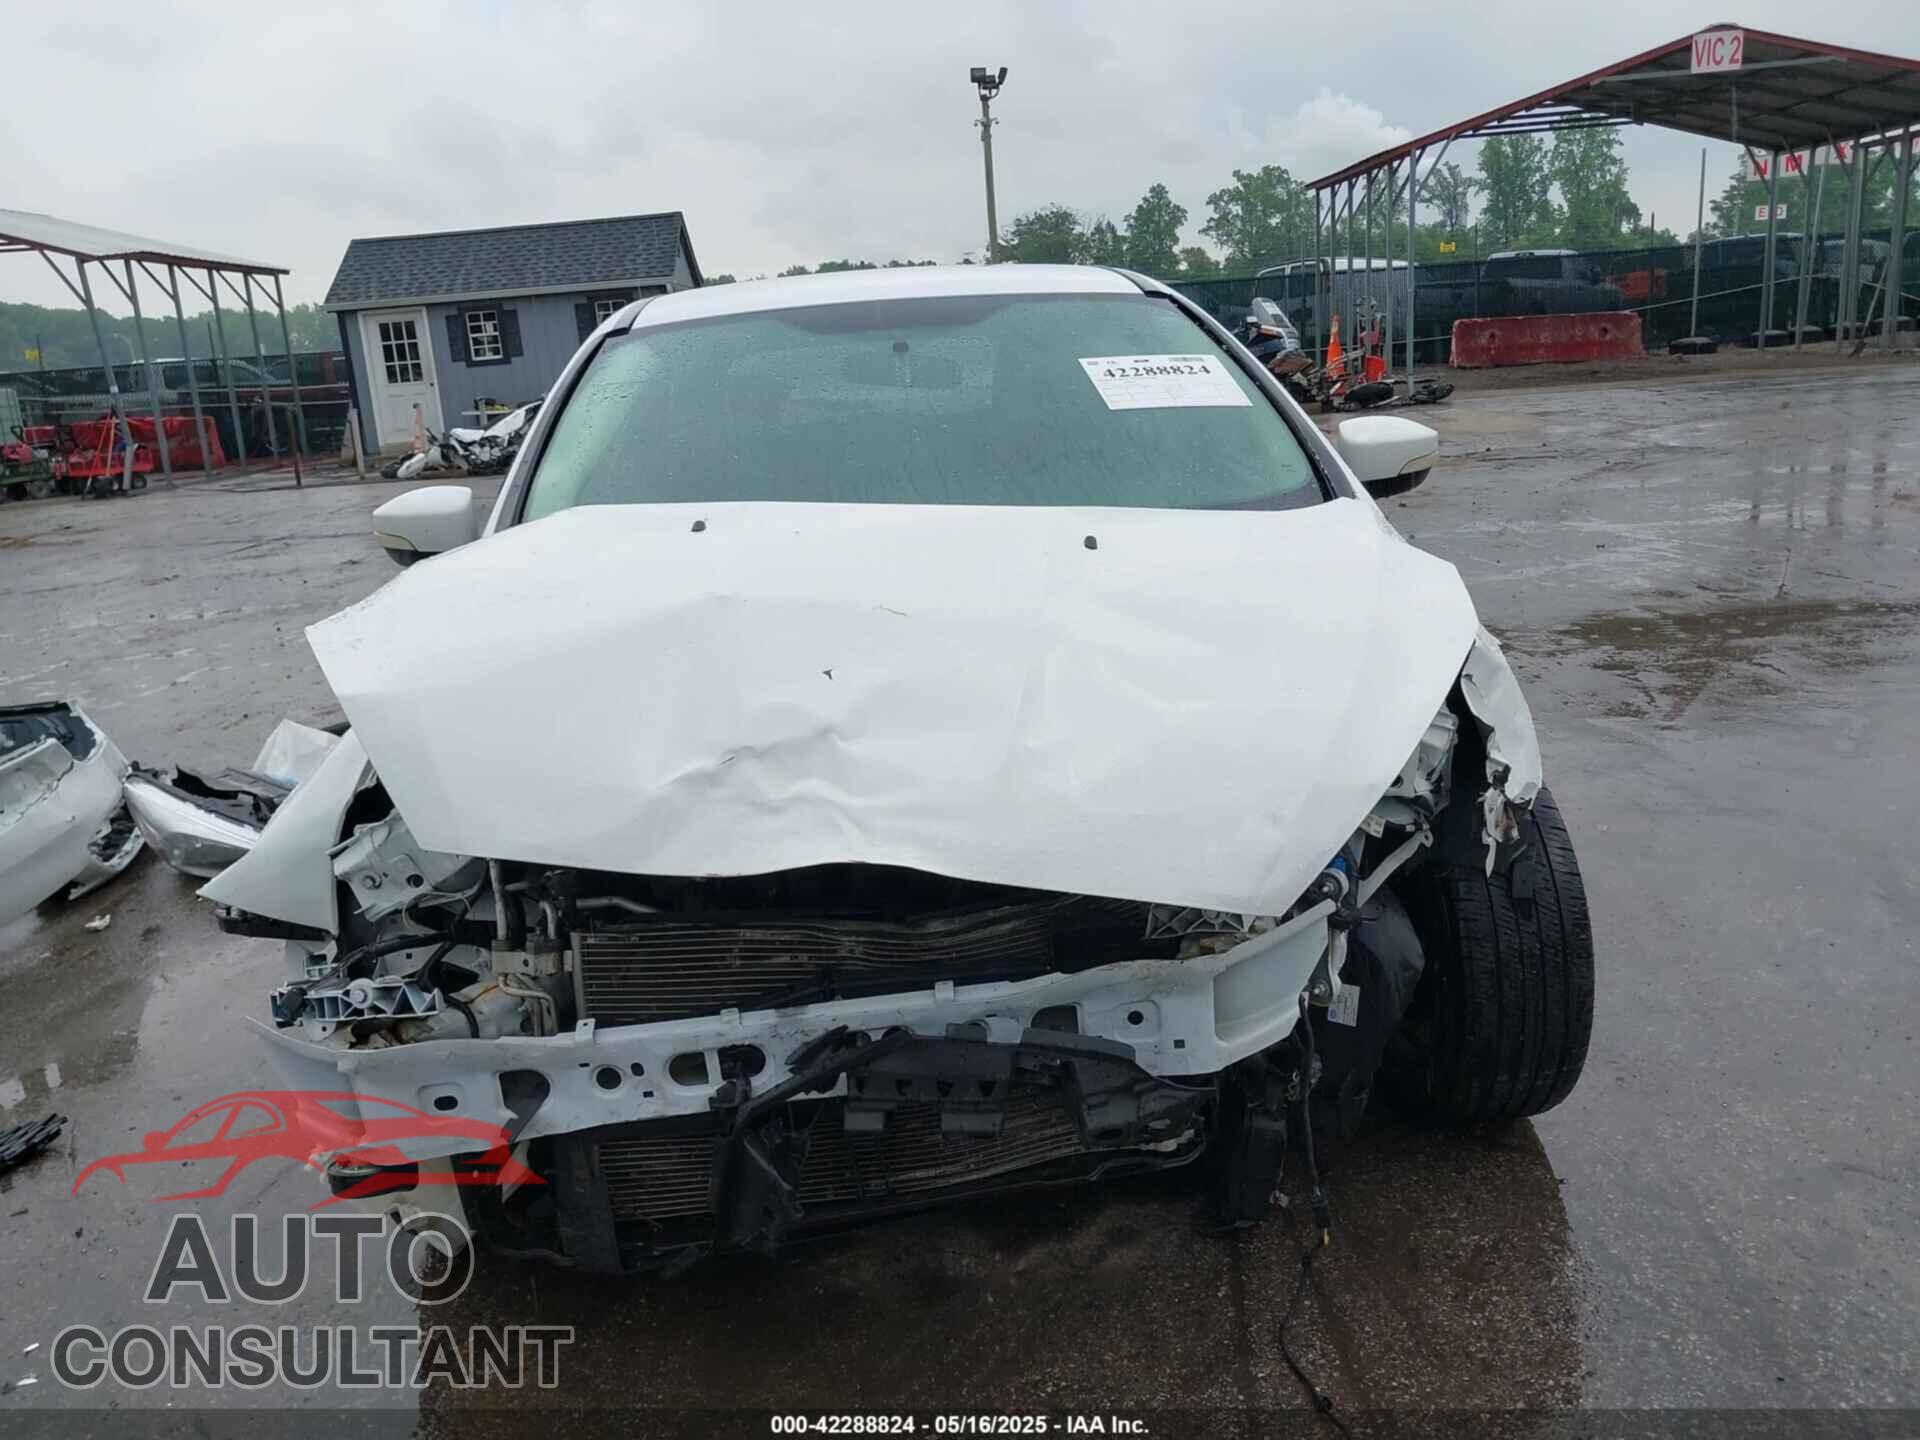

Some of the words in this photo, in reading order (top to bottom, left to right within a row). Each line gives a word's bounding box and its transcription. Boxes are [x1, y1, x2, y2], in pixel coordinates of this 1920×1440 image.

[1694, 36, 1724, 67] VIC
[1729, 34, 1741, 65] 2
[1103, 365, 1211, 378] 42288824
